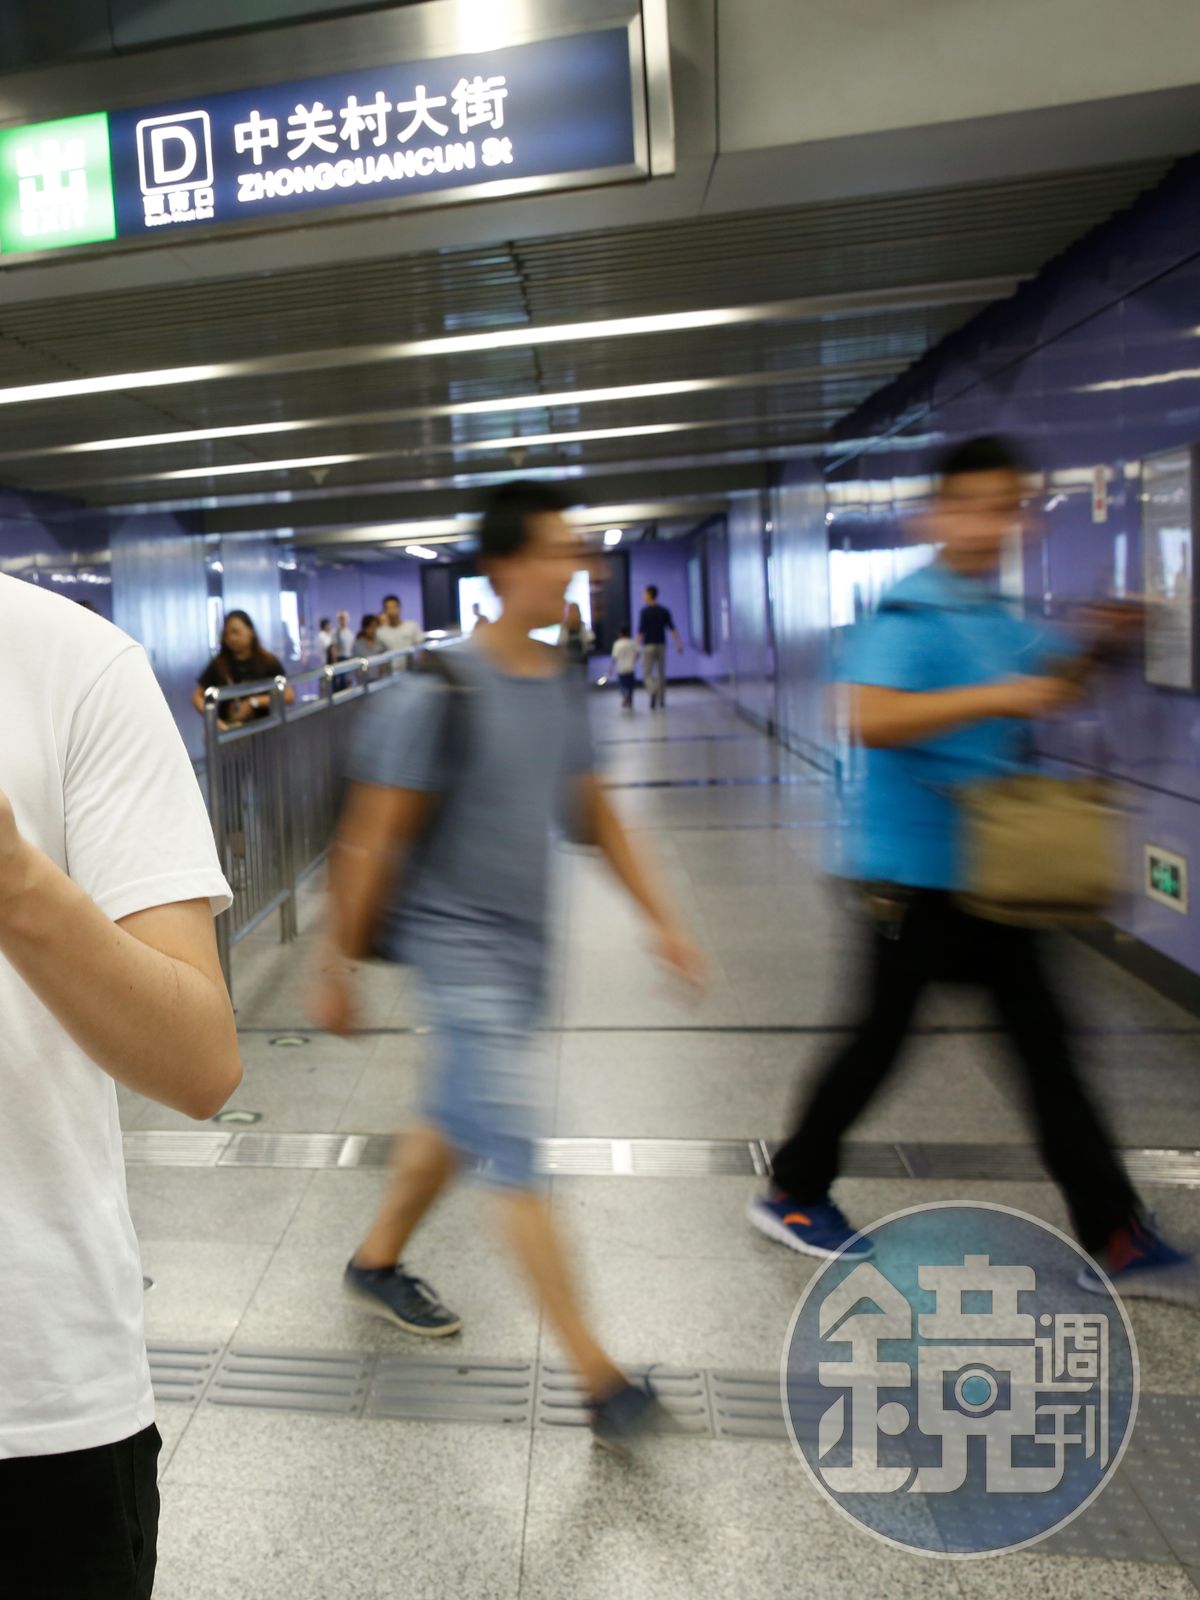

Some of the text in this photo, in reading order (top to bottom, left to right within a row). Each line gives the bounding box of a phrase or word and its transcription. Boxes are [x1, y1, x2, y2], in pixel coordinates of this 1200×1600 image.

[150, 126, 197, 184] D
[233, 75, 509, 166] 中关村大街
[15, 138, 88, 212] 出
[237, 136, 513, 202] ZHONGGUANCUN St
